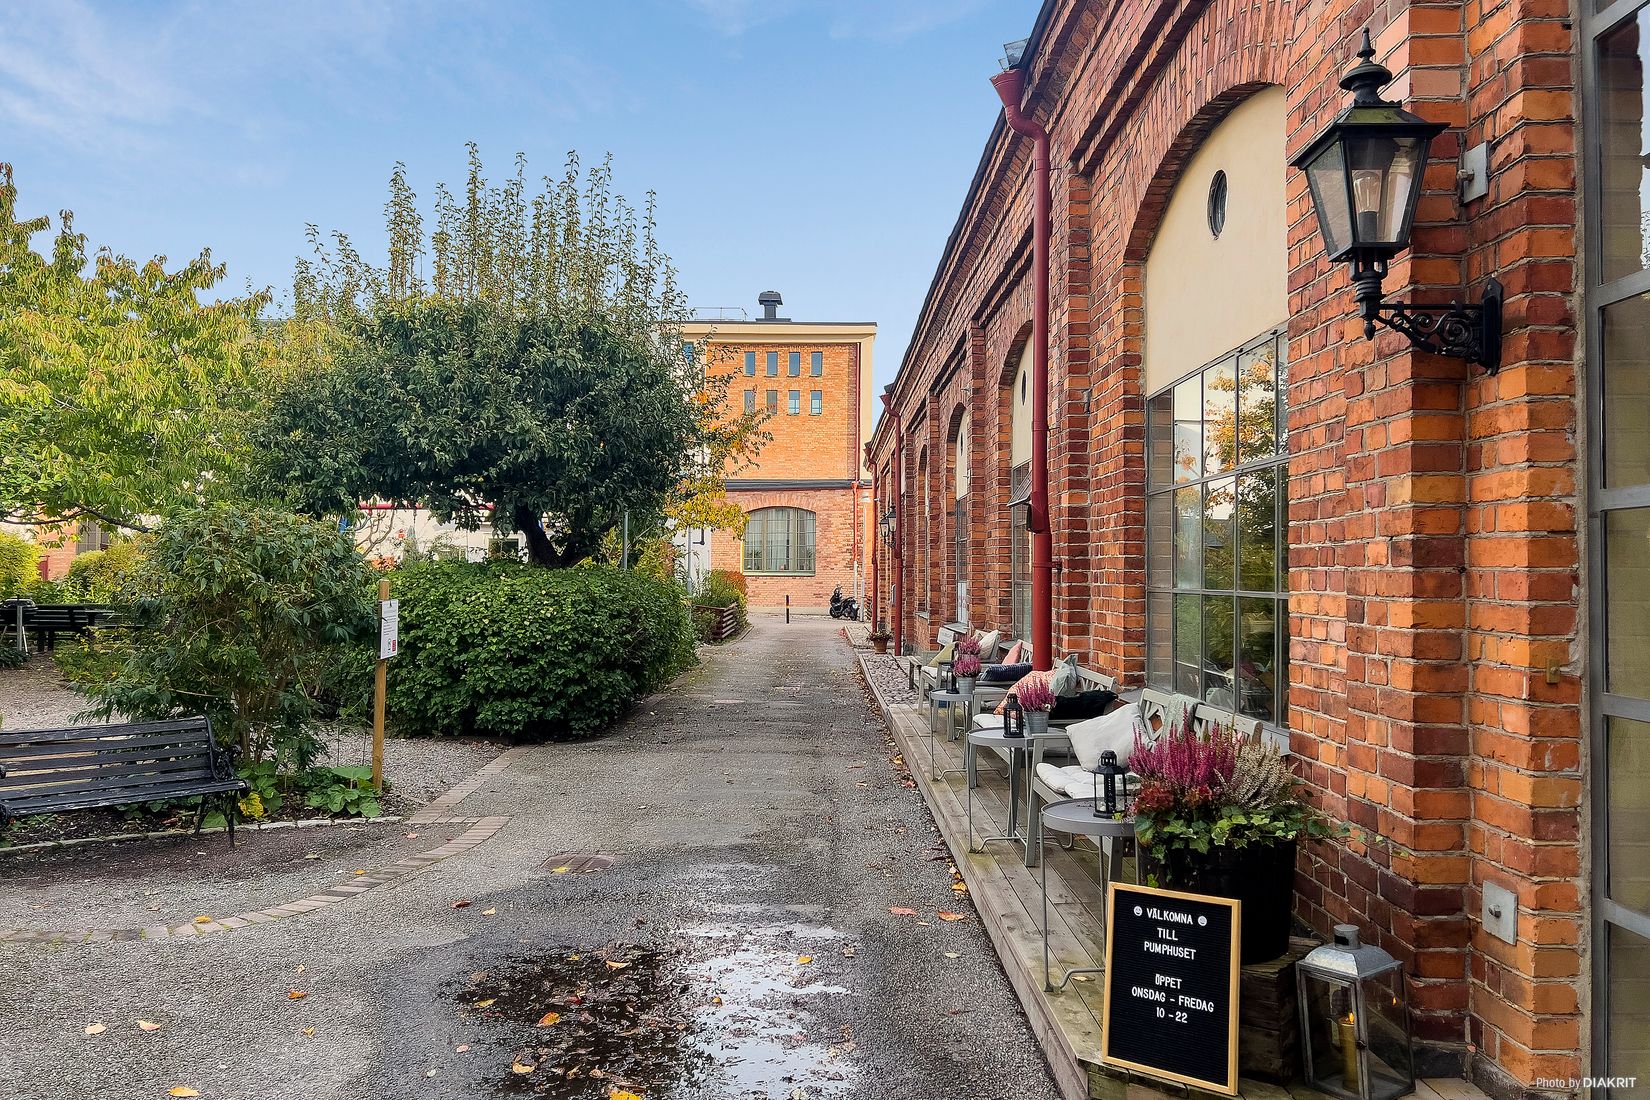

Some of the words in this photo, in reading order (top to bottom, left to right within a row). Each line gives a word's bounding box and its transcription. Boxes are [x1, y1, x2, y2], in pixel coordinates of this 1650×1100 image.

[1146, 907, 1194, 925] VÄLKOMNA
[1157, 927, 1179, 941] TILL
[1143, 941, 1197, 960] PUMPHUSET
[1155, 973, 1182, 989] ÖPPET
[1131, 986, 1166, 1003] ONSDAG
[1178, 994, 1215, 1013] FREDAG
[1156, 1006, 1166, 1019] 10
[1175, 1011, 1188, 1023] 22
